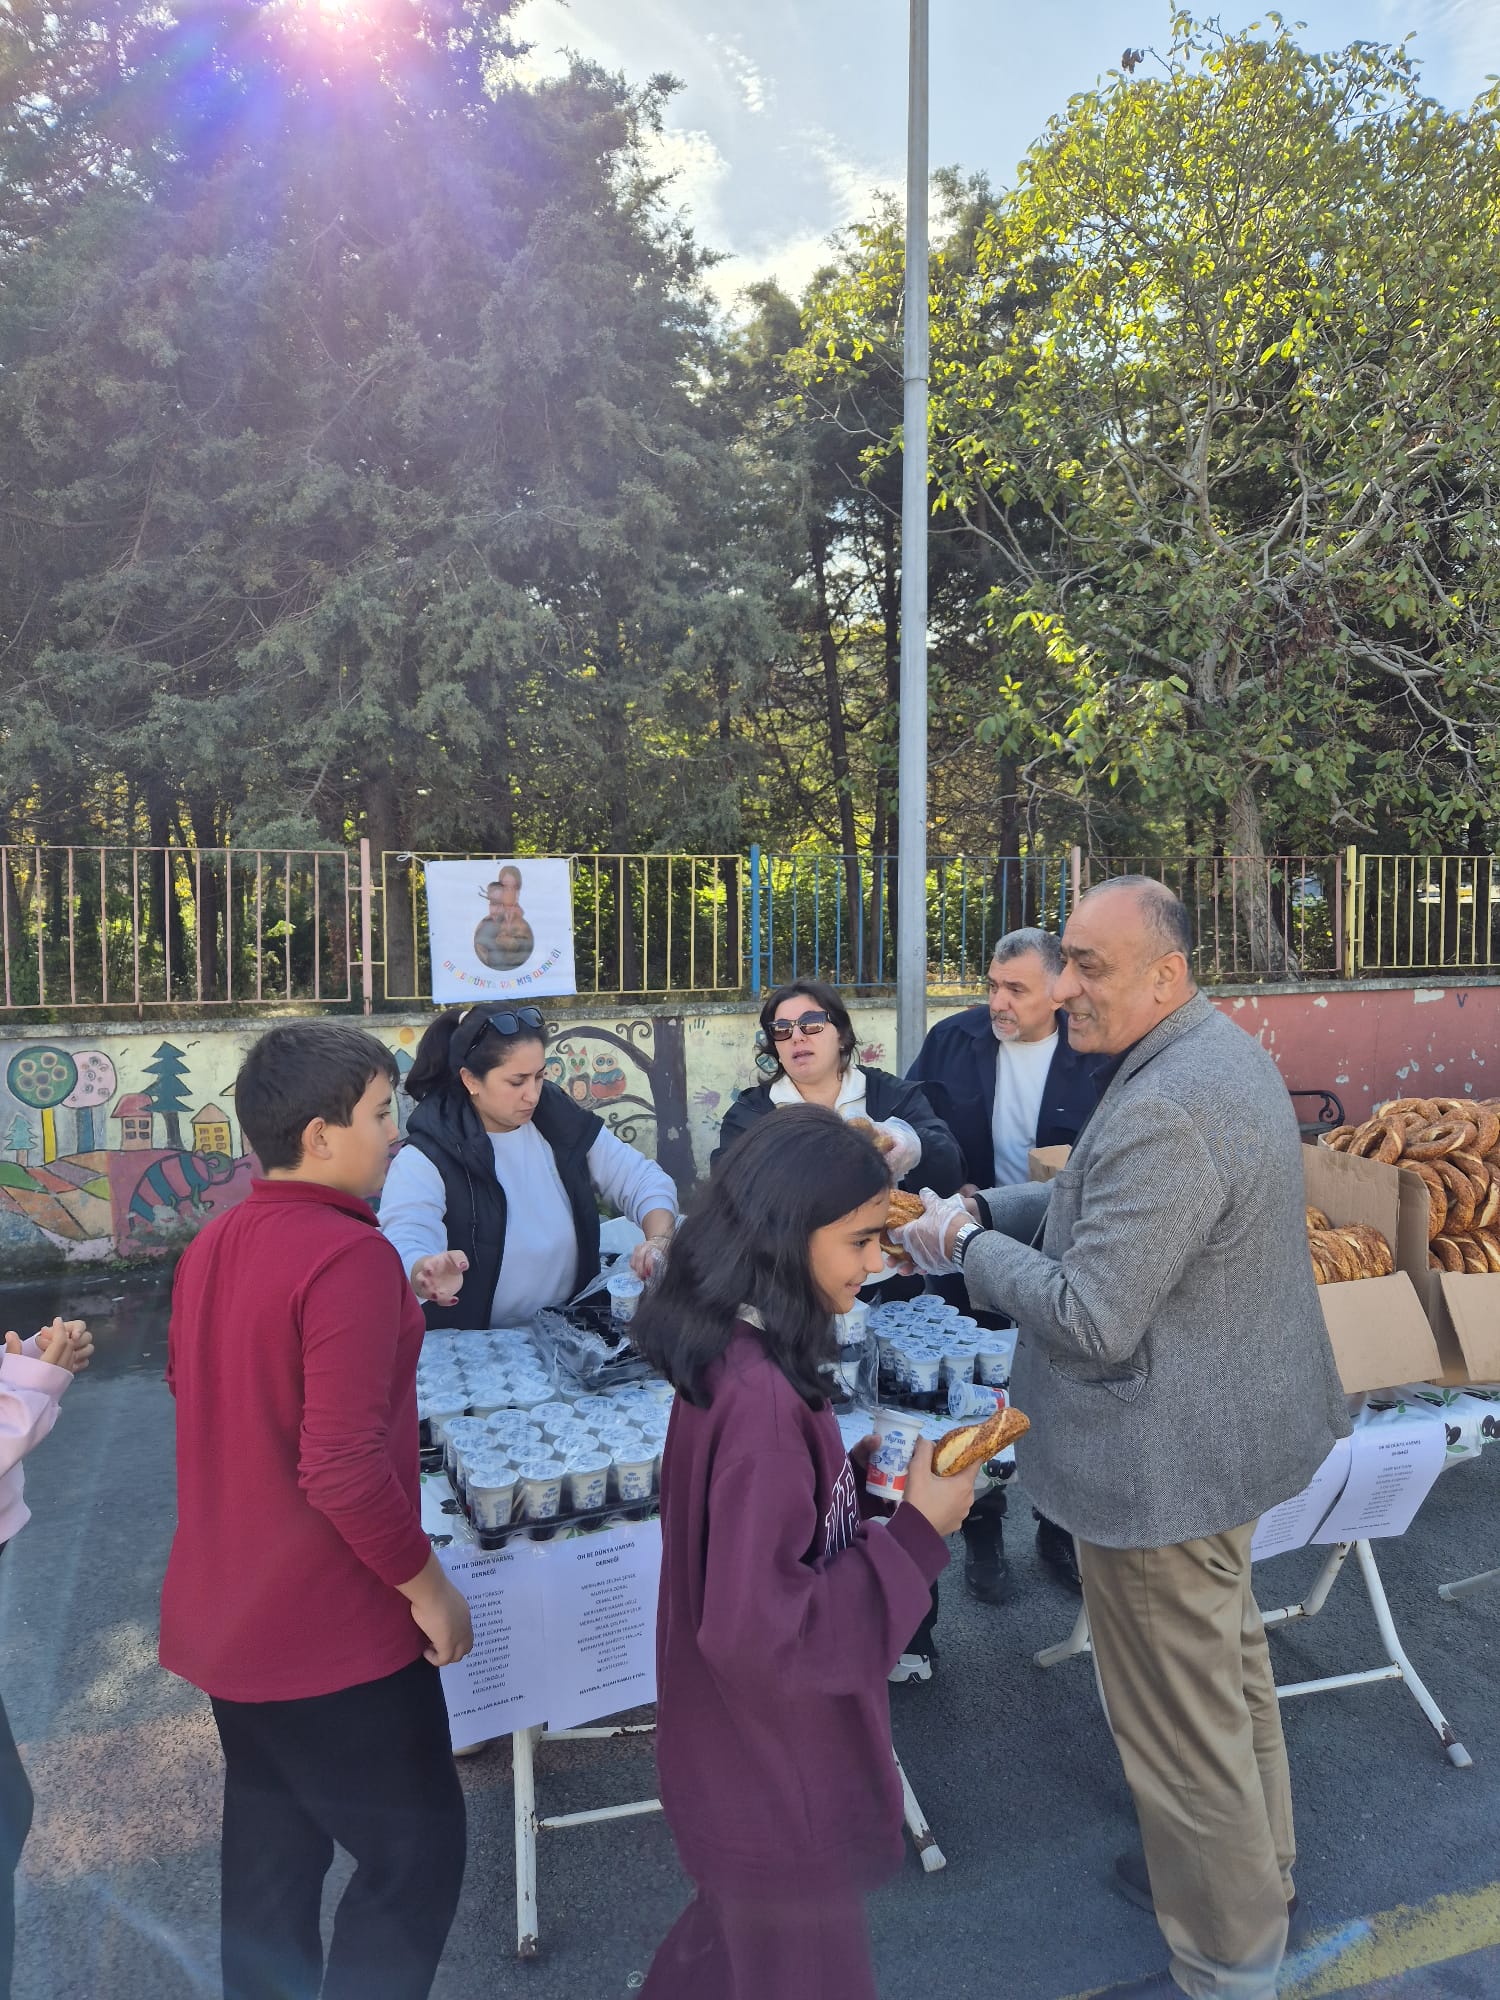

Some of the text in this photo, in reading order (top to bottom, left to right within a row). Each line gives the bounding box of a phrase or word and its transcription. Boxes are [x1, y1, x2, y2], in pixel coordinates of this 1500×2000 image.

[442, 959, 456, 972] OH
[500, 974, 533, 989] VARMIŞ
[532, 948, 562, 979] DERNEĞİ
[594, 1547, 614, 1556] DÜNYA
[470, 1558, 490, 1568] DÜNYA
[595, 1555, 619, 1567] DERNEĞİ
[471, 1568, 496, 1578] DERNEĞİ
